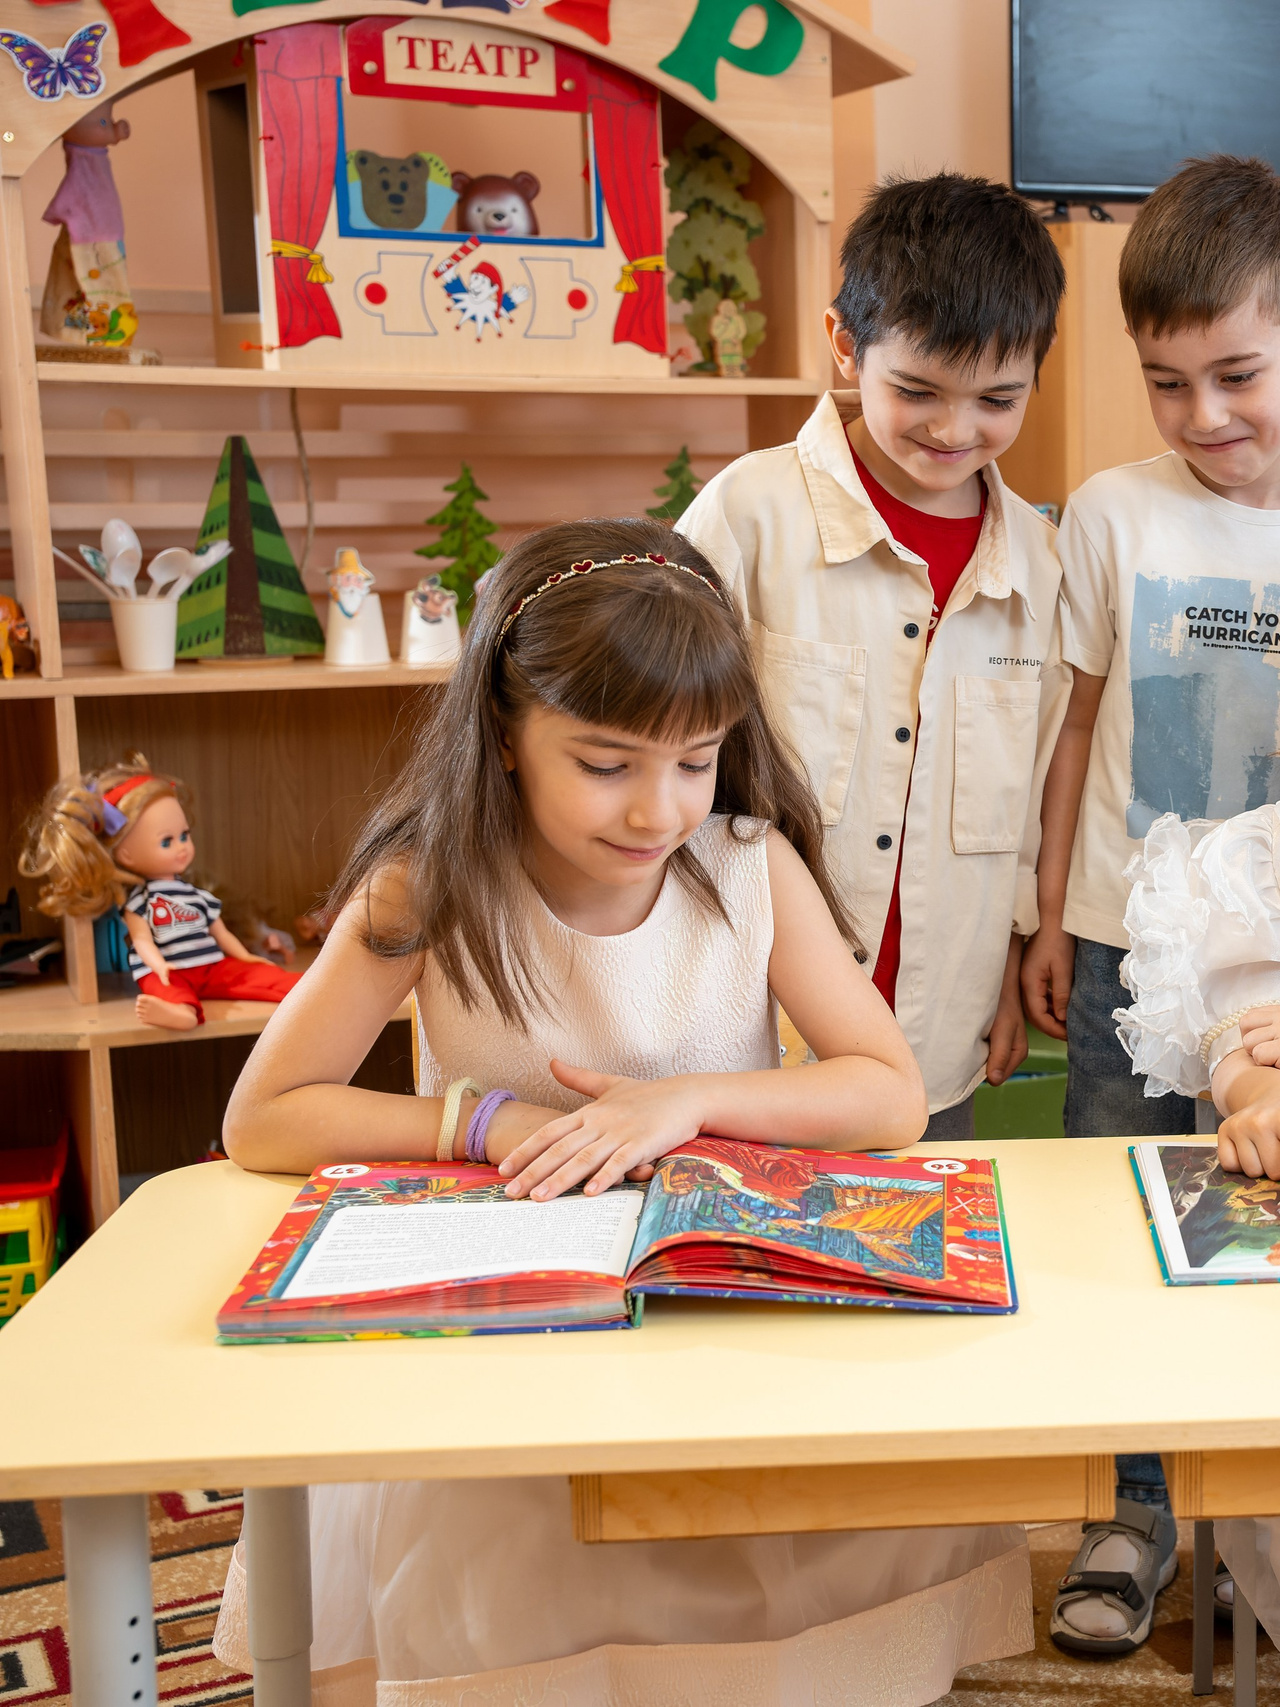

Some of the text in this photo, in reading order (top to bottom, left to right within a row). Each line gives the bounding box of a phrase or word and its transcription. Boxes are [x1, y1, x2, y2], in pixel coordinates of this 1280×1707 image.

[396, 35, 541, 79] ТЕАТР
[1185, 606, 1248, 625] CATCH
[329, 1167, 361, 1175] 37
[930, 1162, 959, 1170] 36
